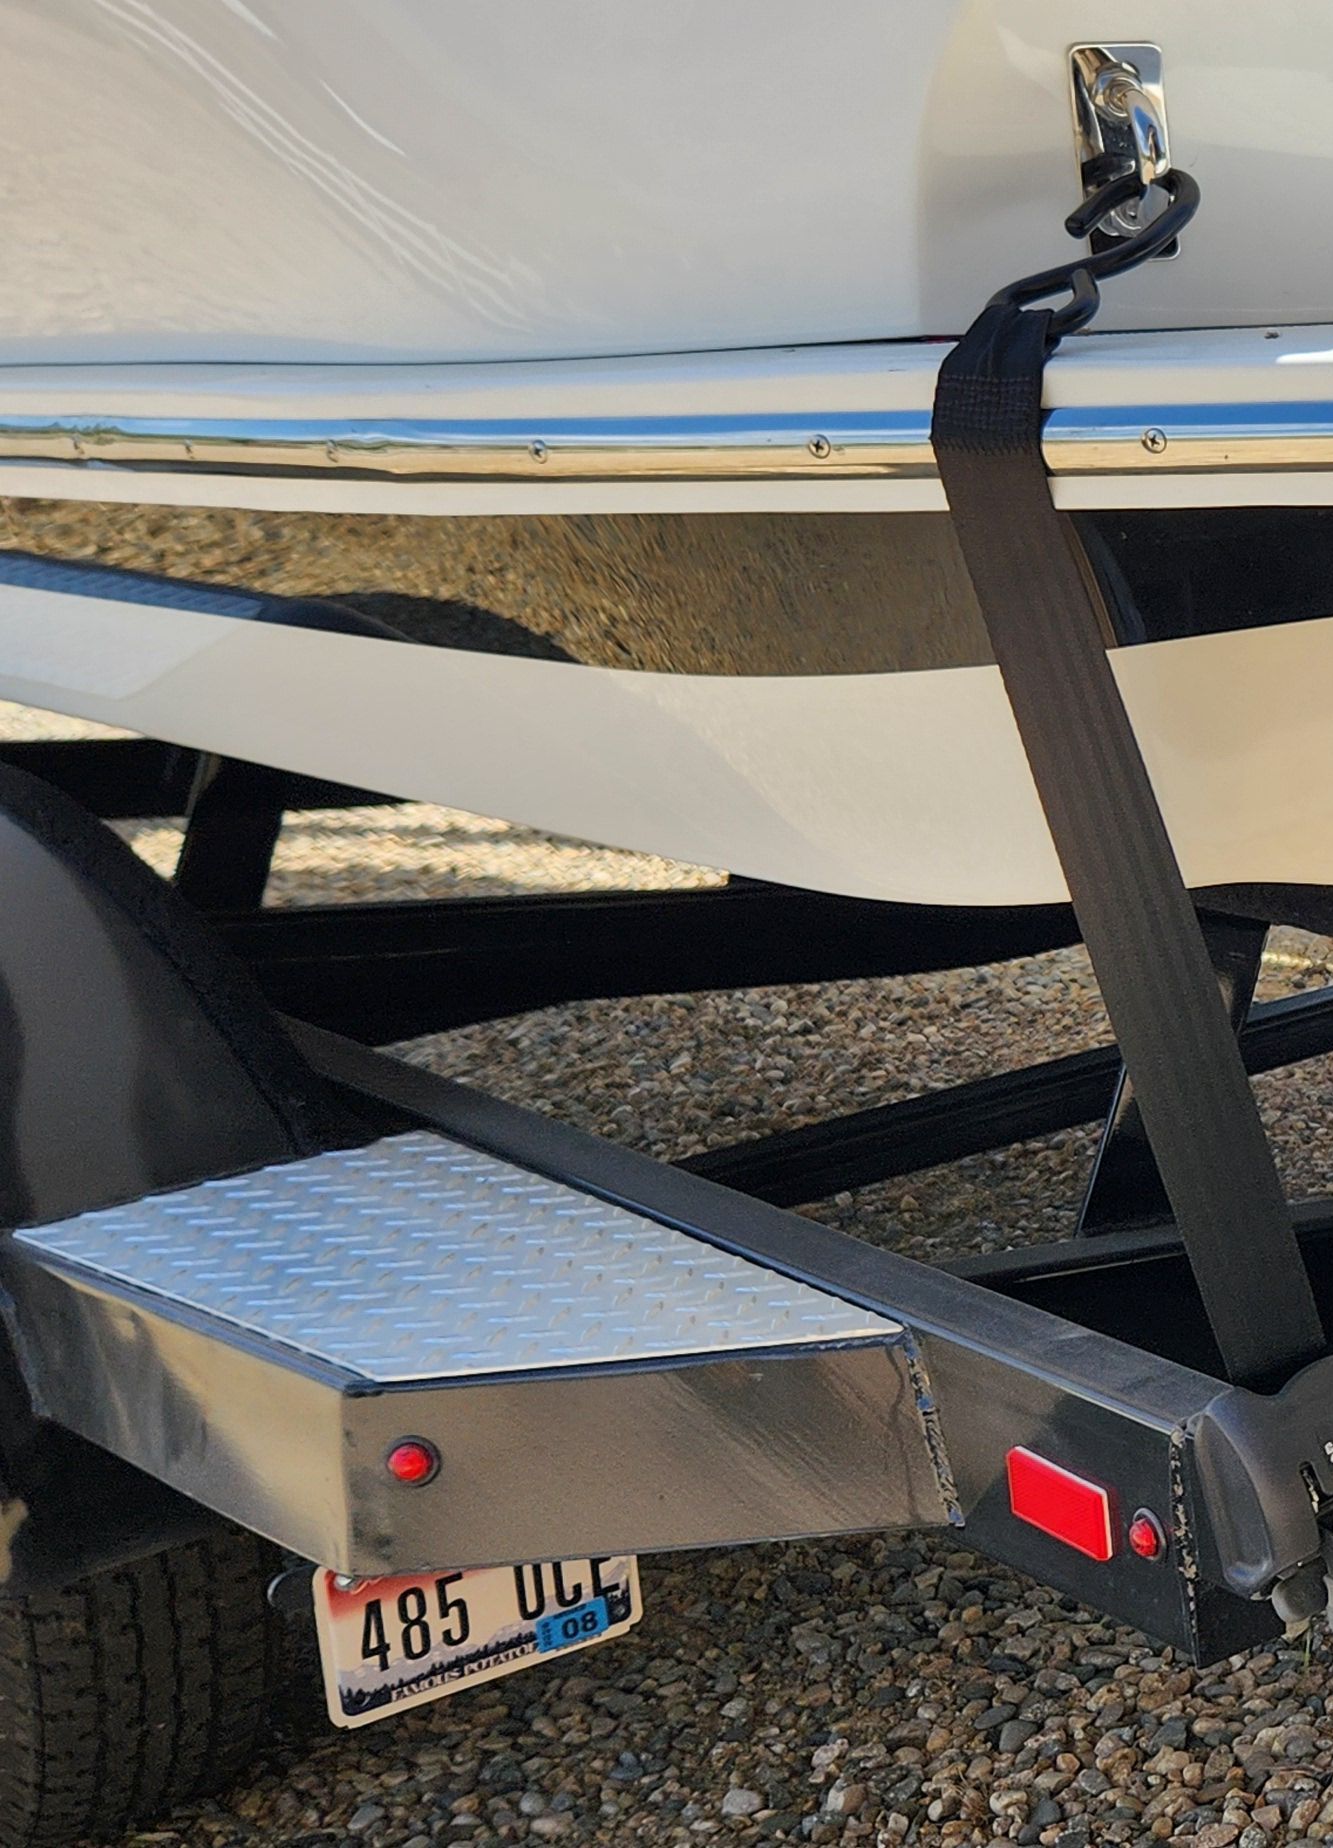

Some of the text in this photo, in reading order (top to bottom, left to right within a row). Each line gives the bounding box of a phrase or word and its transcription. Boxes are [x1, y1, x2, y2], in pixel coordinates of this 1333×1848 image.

[361, 1572, 470, 1672] 485
[561, 1611, 598, 1639] 08
[391, 1642, 538, 1702] FAMOUS POTATO
